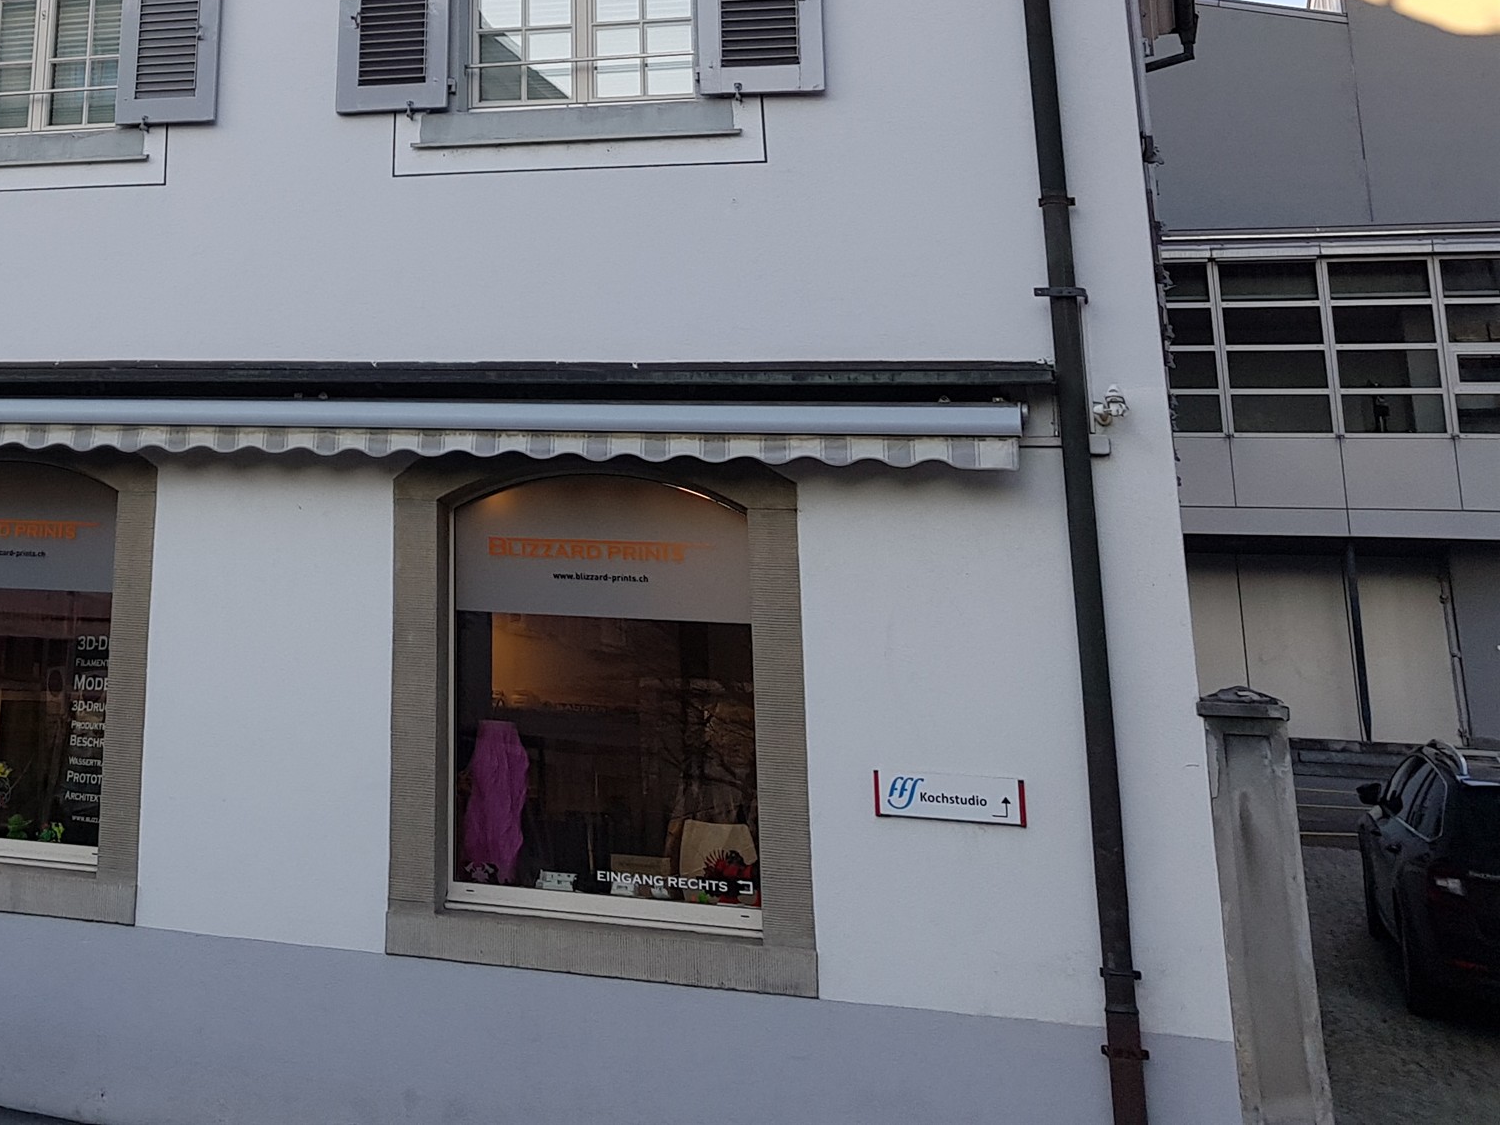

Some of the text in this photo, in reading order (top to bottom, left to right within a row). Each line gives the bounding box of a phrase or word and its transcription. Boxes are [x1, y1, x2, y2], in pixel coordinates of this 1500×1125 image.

[488, 536, 601, 560] BLIZZARD
[552, 572, 649, 583] www.blizzard-prints.ch
[919, 791, 988, 807] Kochstudio
[596, 870, 729, 892] EINGANG RECHTS
